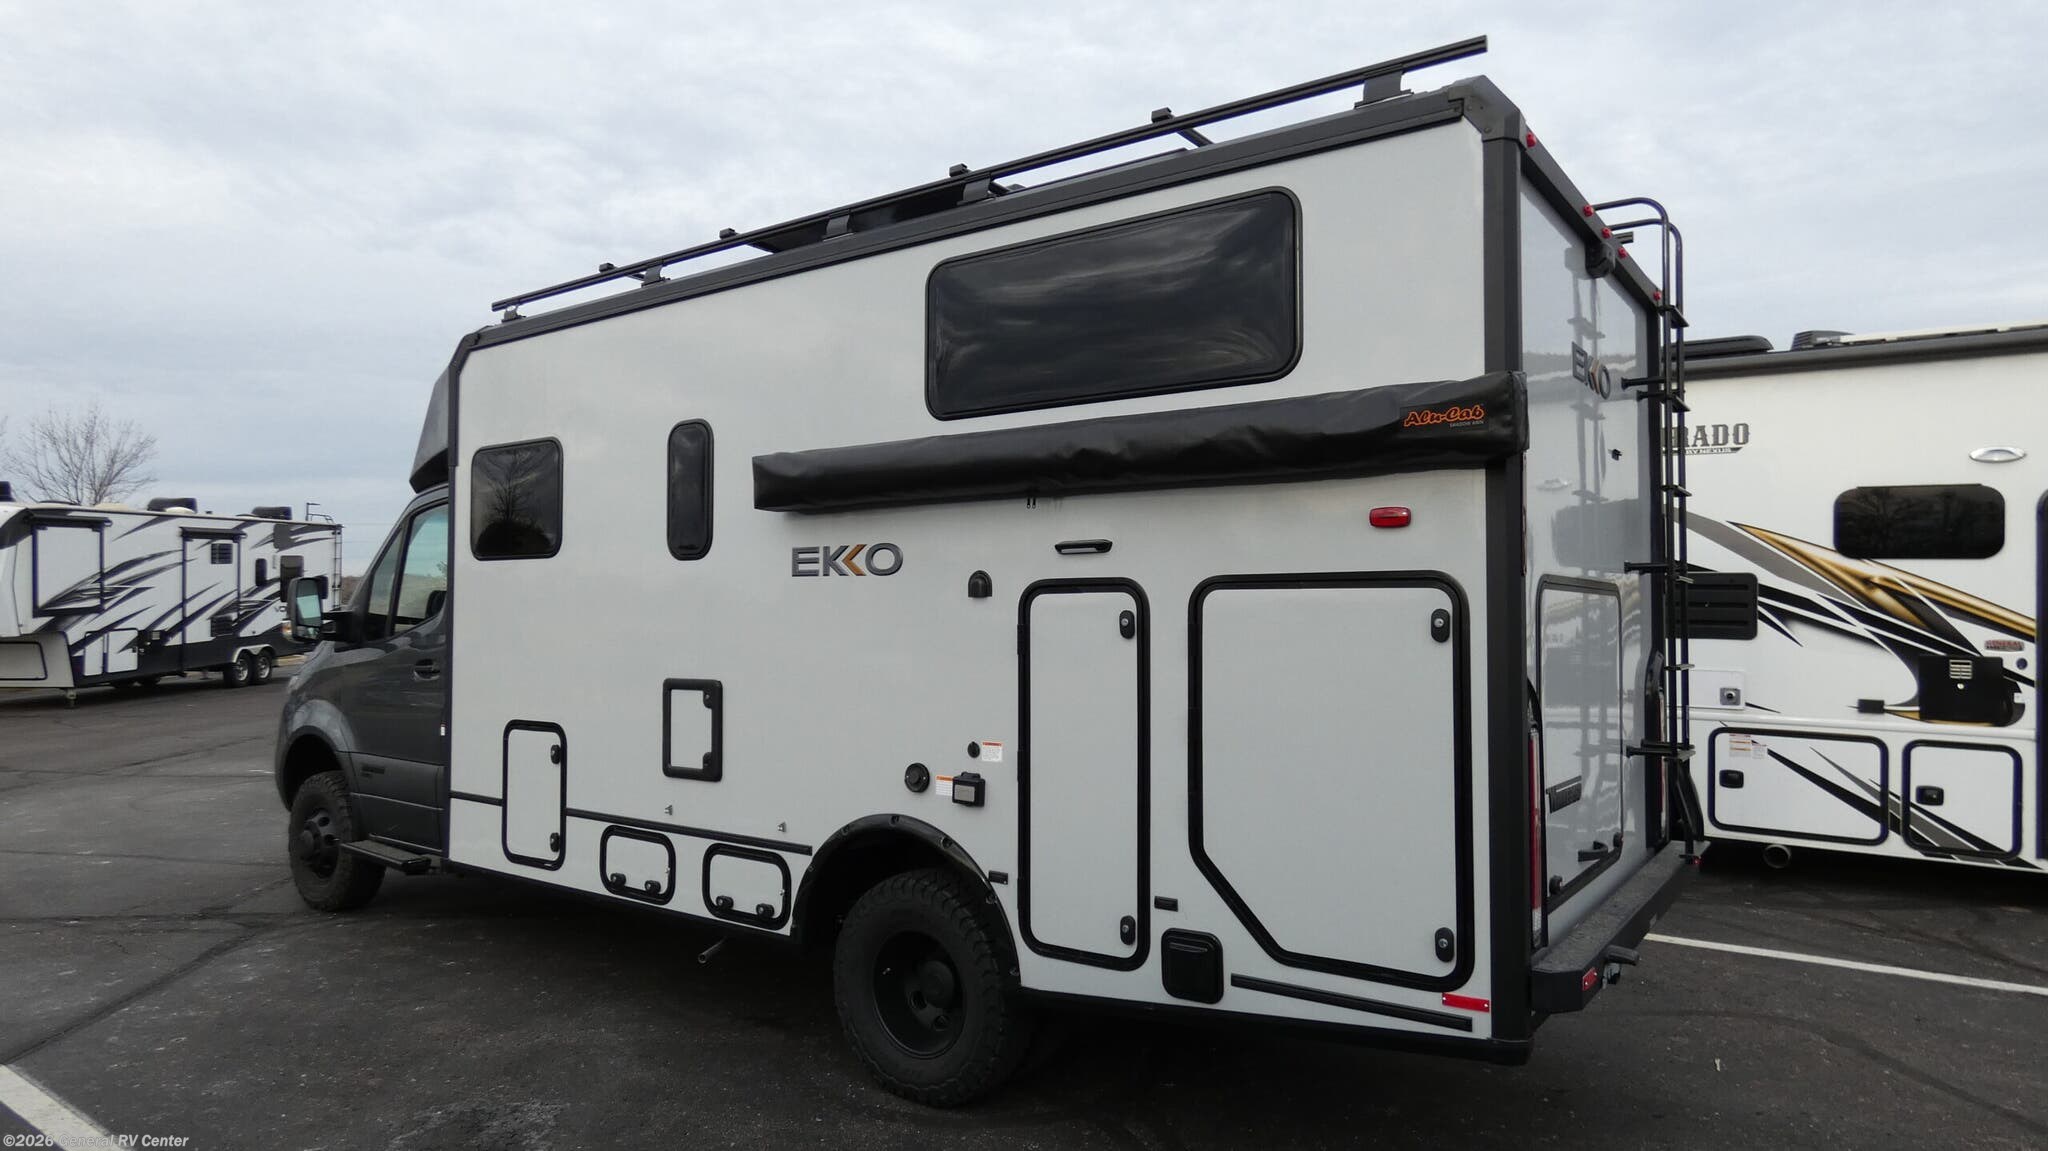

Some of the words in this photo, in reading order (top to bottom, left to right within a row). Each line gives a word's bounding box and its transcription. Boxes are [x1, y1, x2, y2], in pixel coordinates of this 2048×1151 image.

[1571, 341, 1611, 400] EKKO
[1403, 404, 1485, 427] Alu-Cab
[791, 542, 904, 577] EKKO
